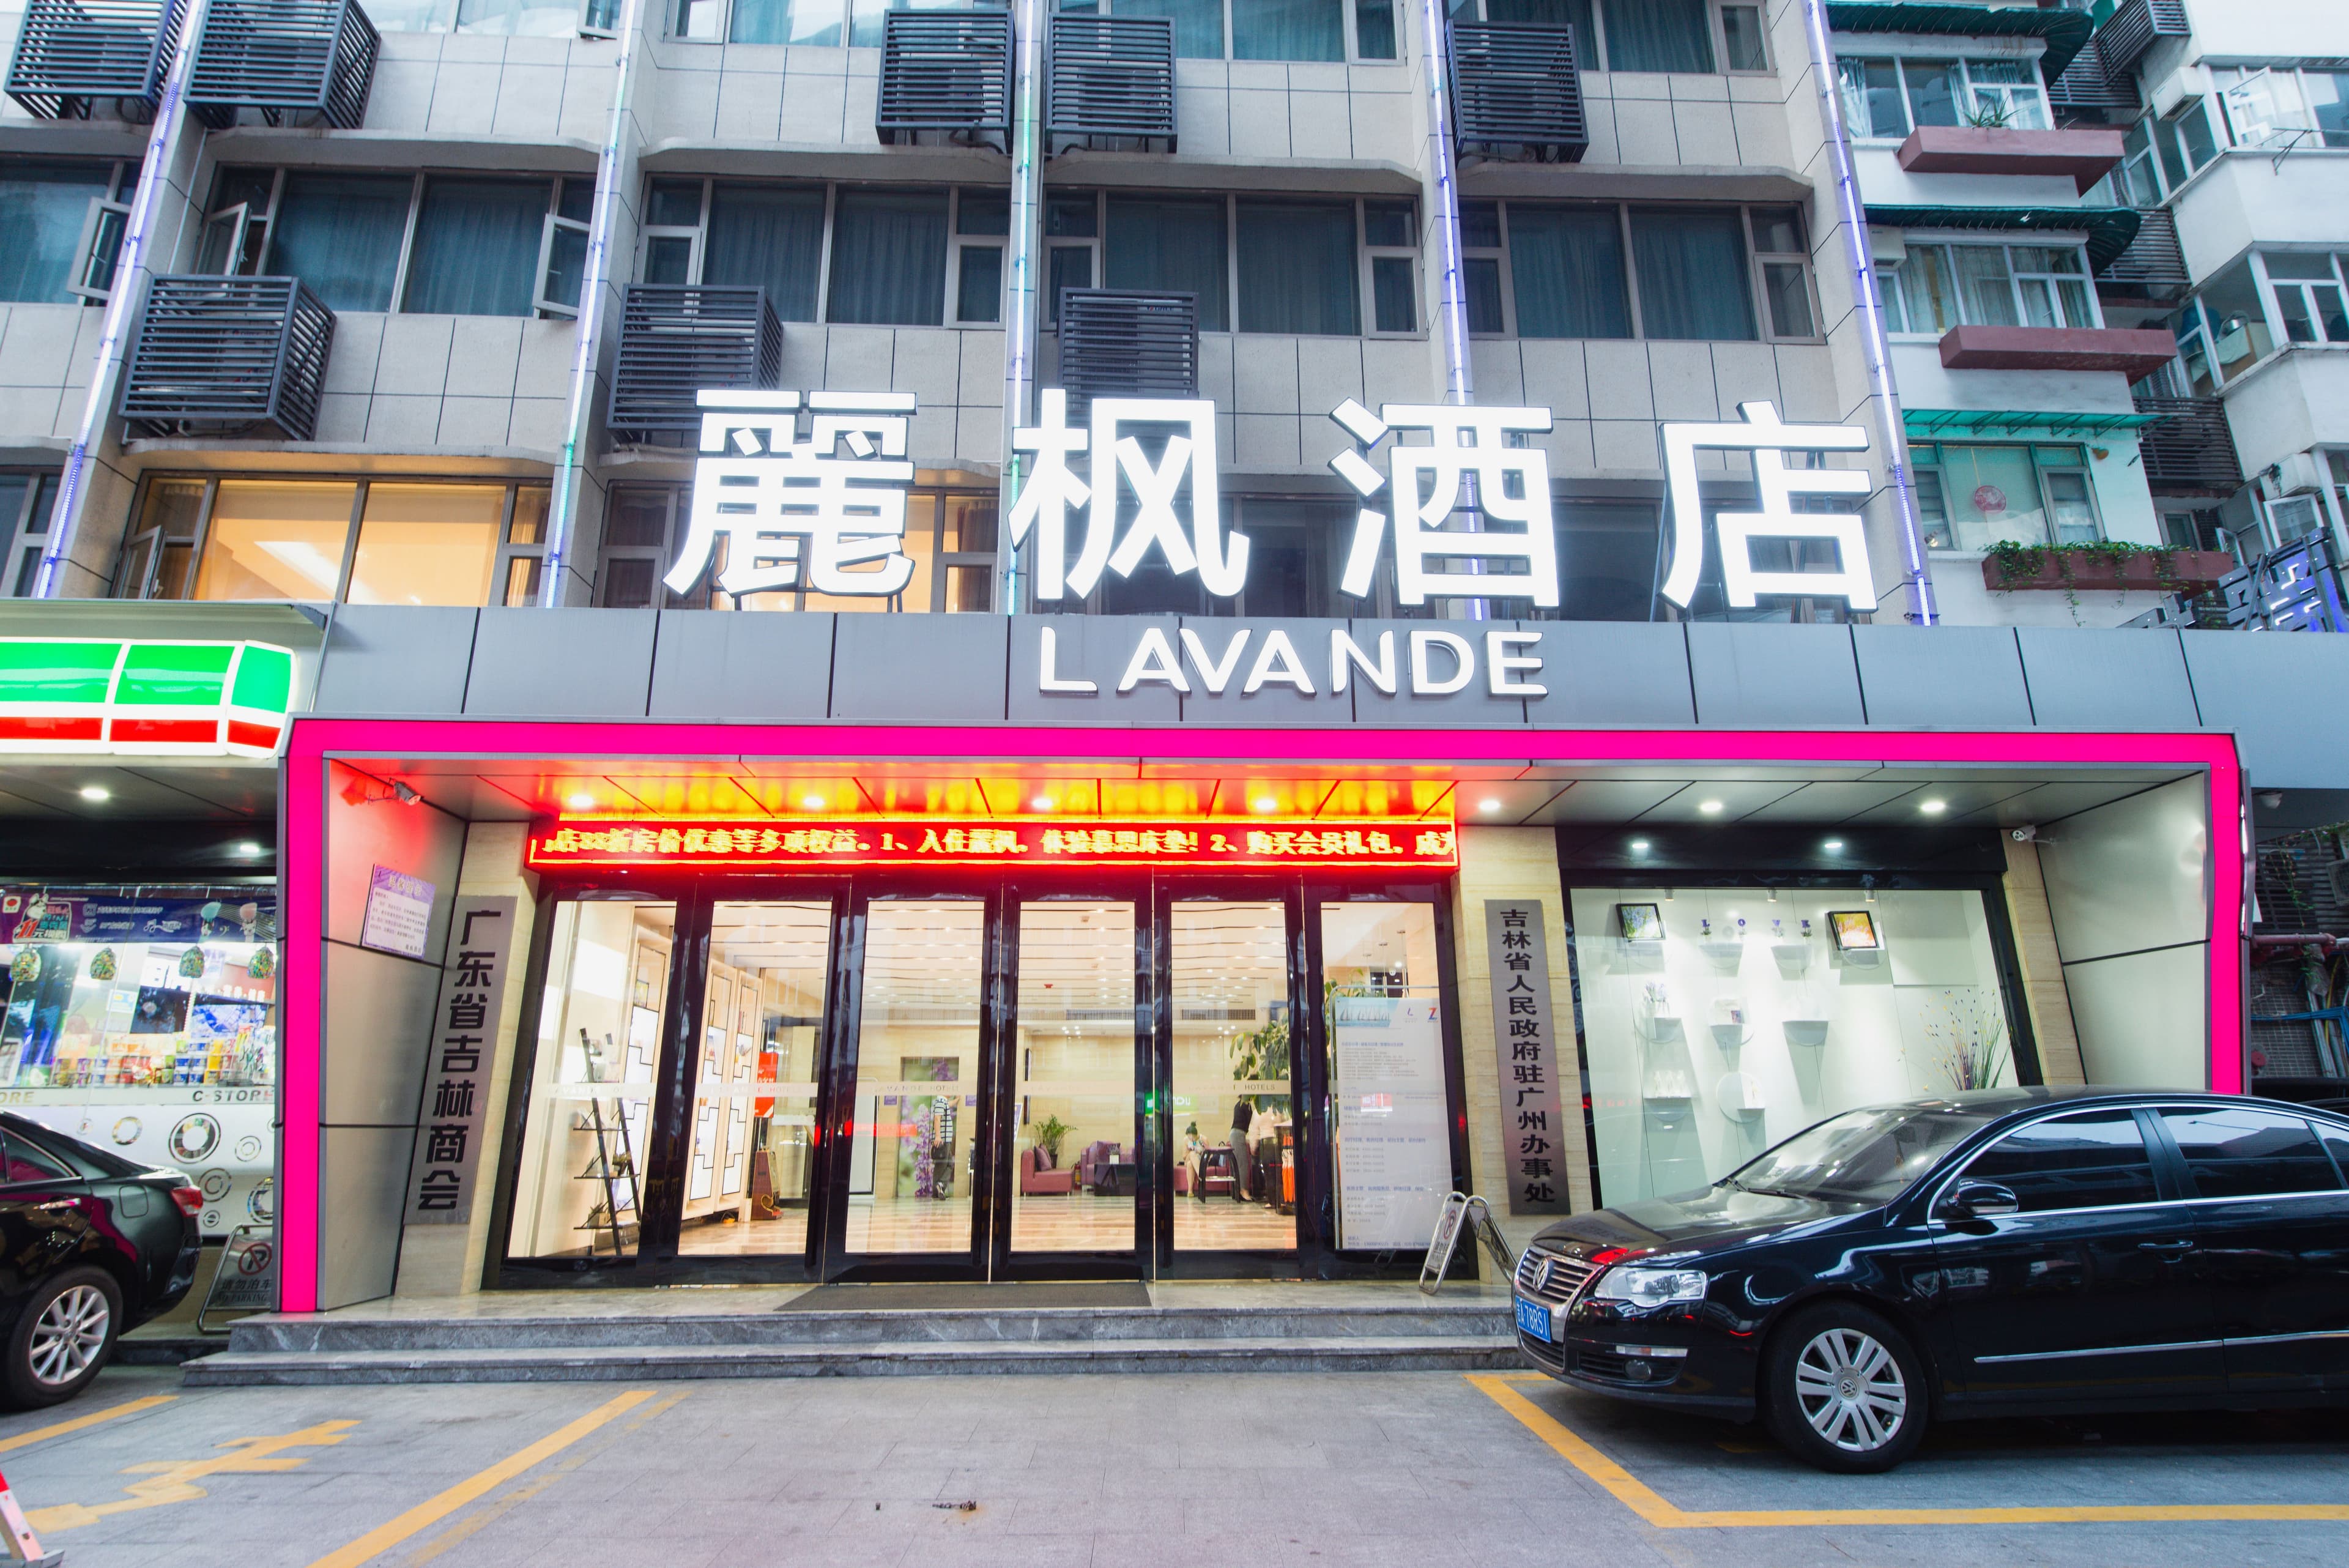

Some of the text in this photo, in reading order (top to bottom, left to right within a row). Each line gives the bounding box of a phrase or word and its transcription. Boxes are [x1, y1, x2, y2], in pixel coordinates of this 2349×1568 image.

[663, 389, 1878, 612] 麗枫酒店
[1039, 626, 1548, 697] LAVANDE
[418, 909, 502, 1211] 广东省吉林商会
[1499, 908, 1556, 1203] 吉林省人民政府驻广州办事处
[232, 1291, 267, 1302] PARKING
